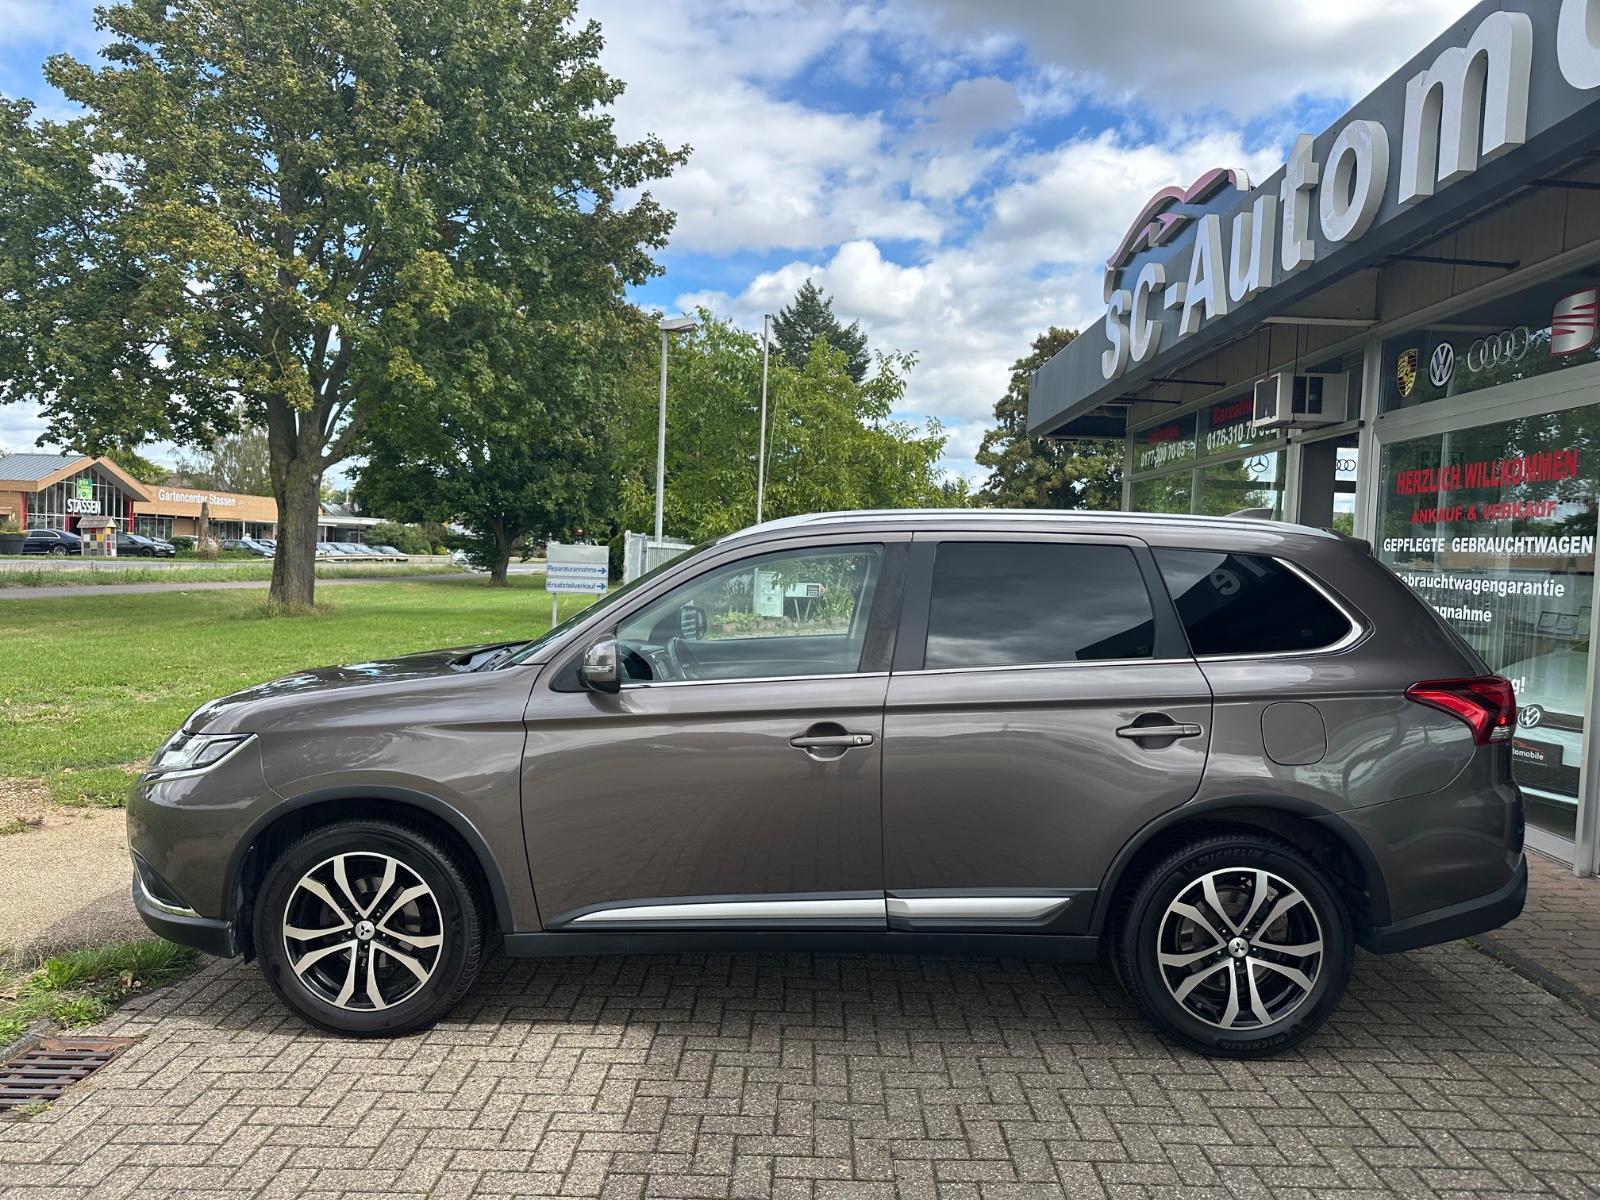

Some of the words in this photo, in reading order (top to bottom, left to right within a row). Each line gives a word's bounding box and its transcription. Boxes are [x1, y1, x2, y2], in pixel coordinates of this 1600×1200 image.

[1396, 464, 1461, 495] HERZLICH
[1464, 448, 1580, 489] WILLKOMMEN
[67, 498, 101, 514] STASSEN
[158, 489, 208, 504] Gartencenter
[209, 493, 236, 506] Stassen
[1410, 503, 1463, 525] ANKAUF
[1466, 503, 1478, 522] &
[1482, 500, 1557, 521] VERKAUF
[1383, 537, 1446, 553] GEPFLEGTE
[1451, 535, 1594, 554] GEBRAUCHTWAGEN
